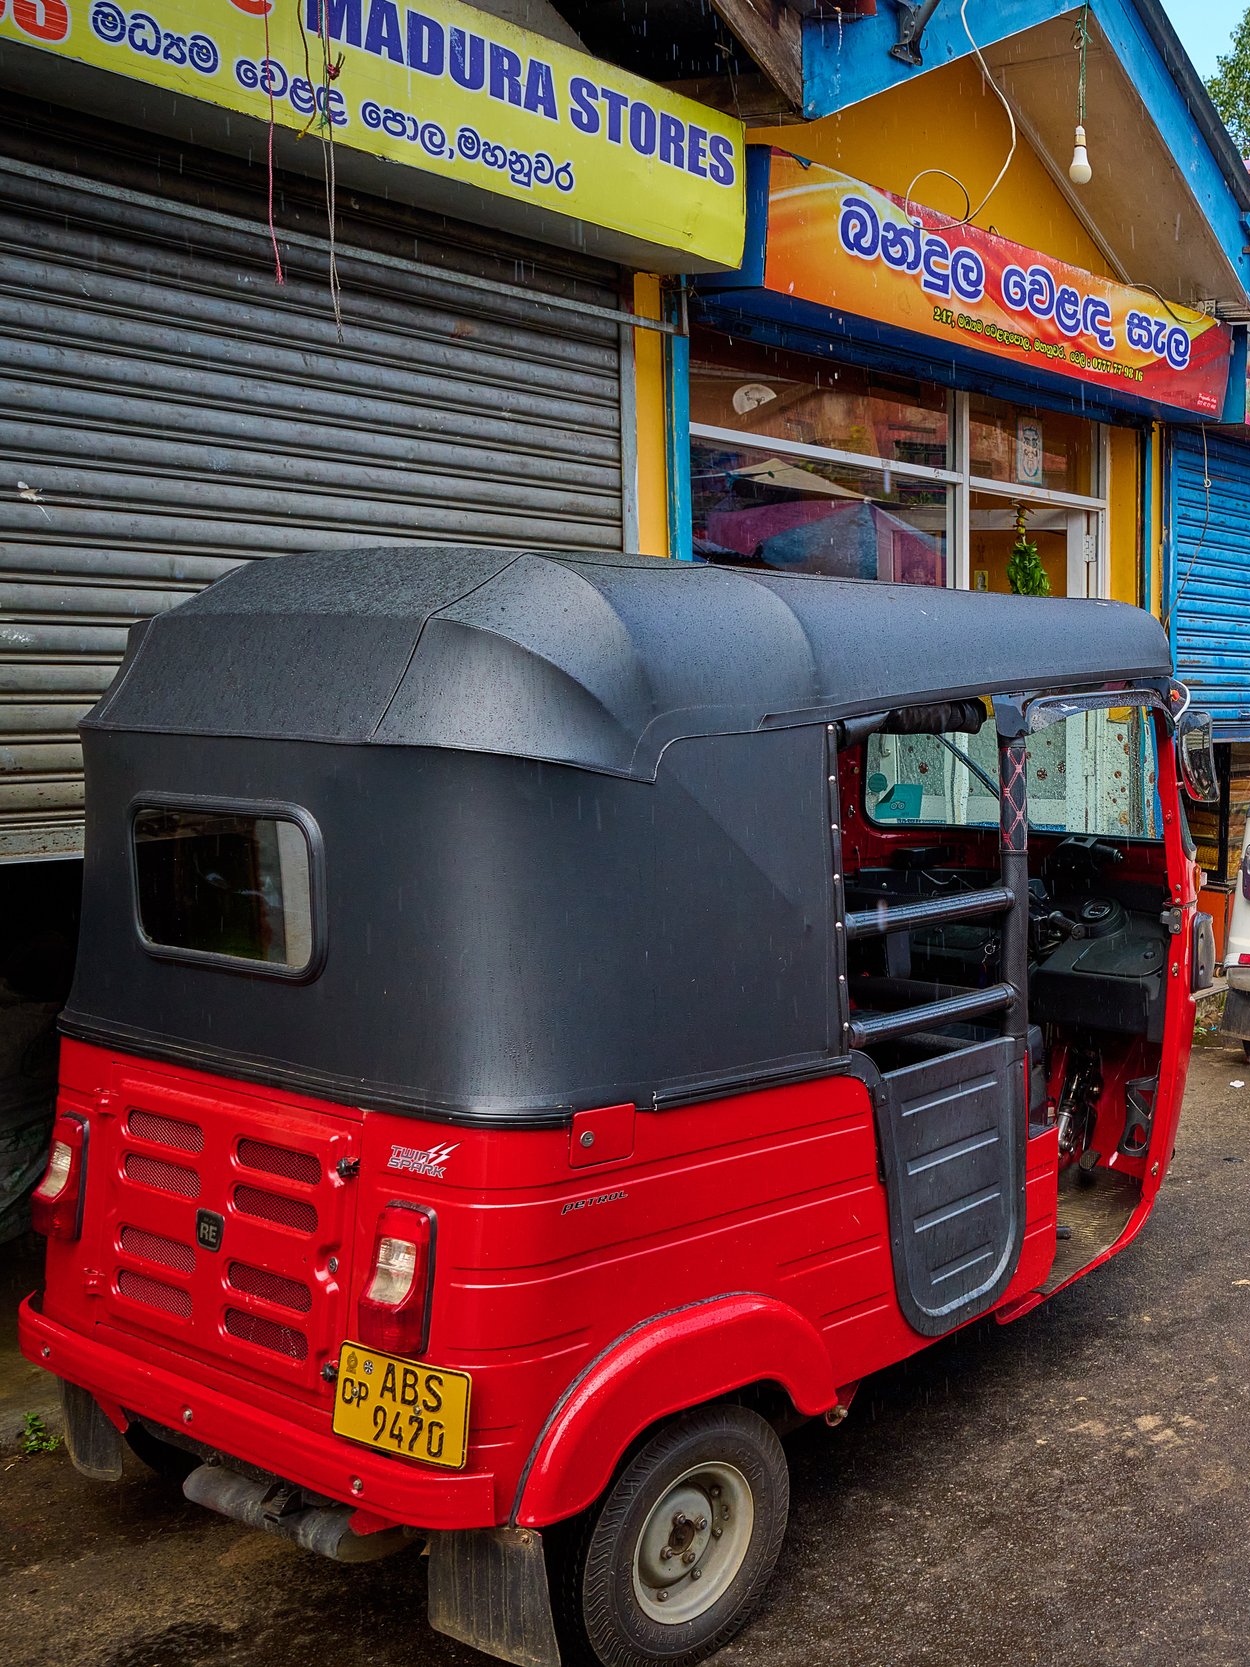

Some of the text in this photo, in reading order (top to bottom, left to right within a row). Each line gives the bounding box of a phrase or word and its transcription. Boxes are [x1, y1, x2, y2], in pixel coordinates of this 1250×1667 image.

[306, 0, 735, 187] MADURA STORES
[839, 196, 984, 301] බන්දුල
[1127, 311, 1190, 369] සැල
[387, 1157, 447, 1179] SPARK
[391, 1145, 431, 1162] TWIN
[200, 1222, 217, 1243] RE
[342, 1362, 444, 1413] CP ABS
[373, 1405, 445, 1458] 9470
